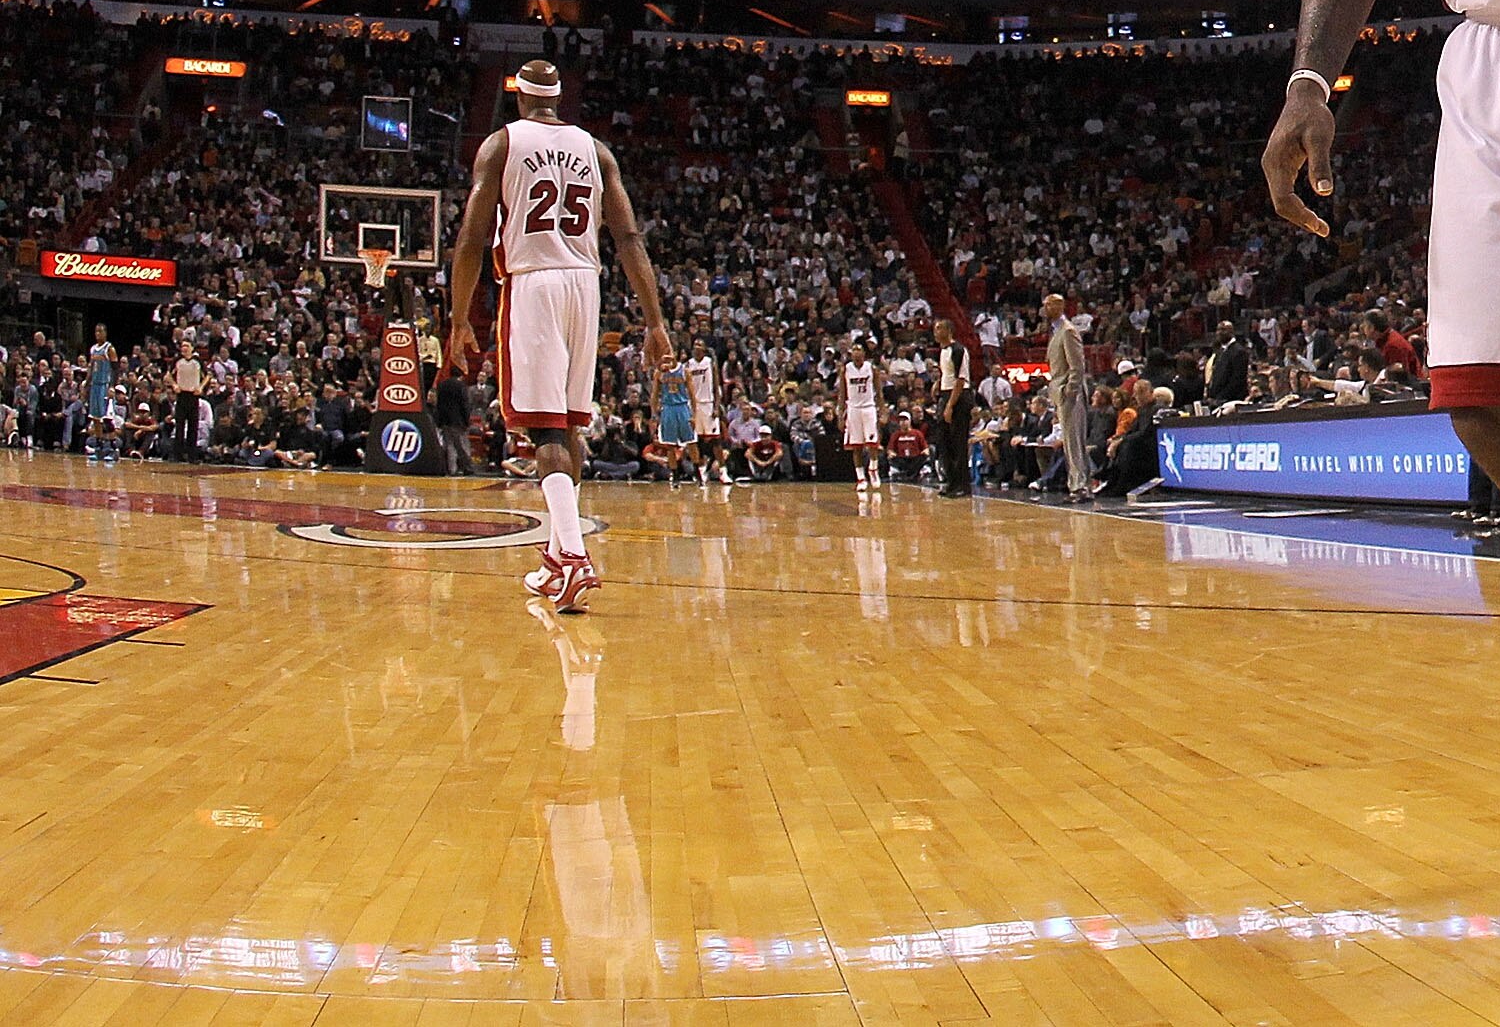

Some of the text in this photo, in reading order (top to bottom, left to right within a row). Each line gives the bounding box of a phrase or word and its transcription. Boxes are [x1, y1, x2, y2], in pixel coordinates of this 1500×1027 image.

[183, 60, 231, 74] BACARDI
[523, 149, 592, 180] DAMPIER
[524, 179, 593, 238] 25
[54, 252, 163, 281] Budweiser
[390, 335, 408, 344] KIA
[390, 361, 410, 371] KIA
[389, 389, 412, 400] KIA
[387, 420, 418, 463] hp
[1293, 455, 1342, 472] TRAVEL
[1348, 455, 1385, 473] WITH
